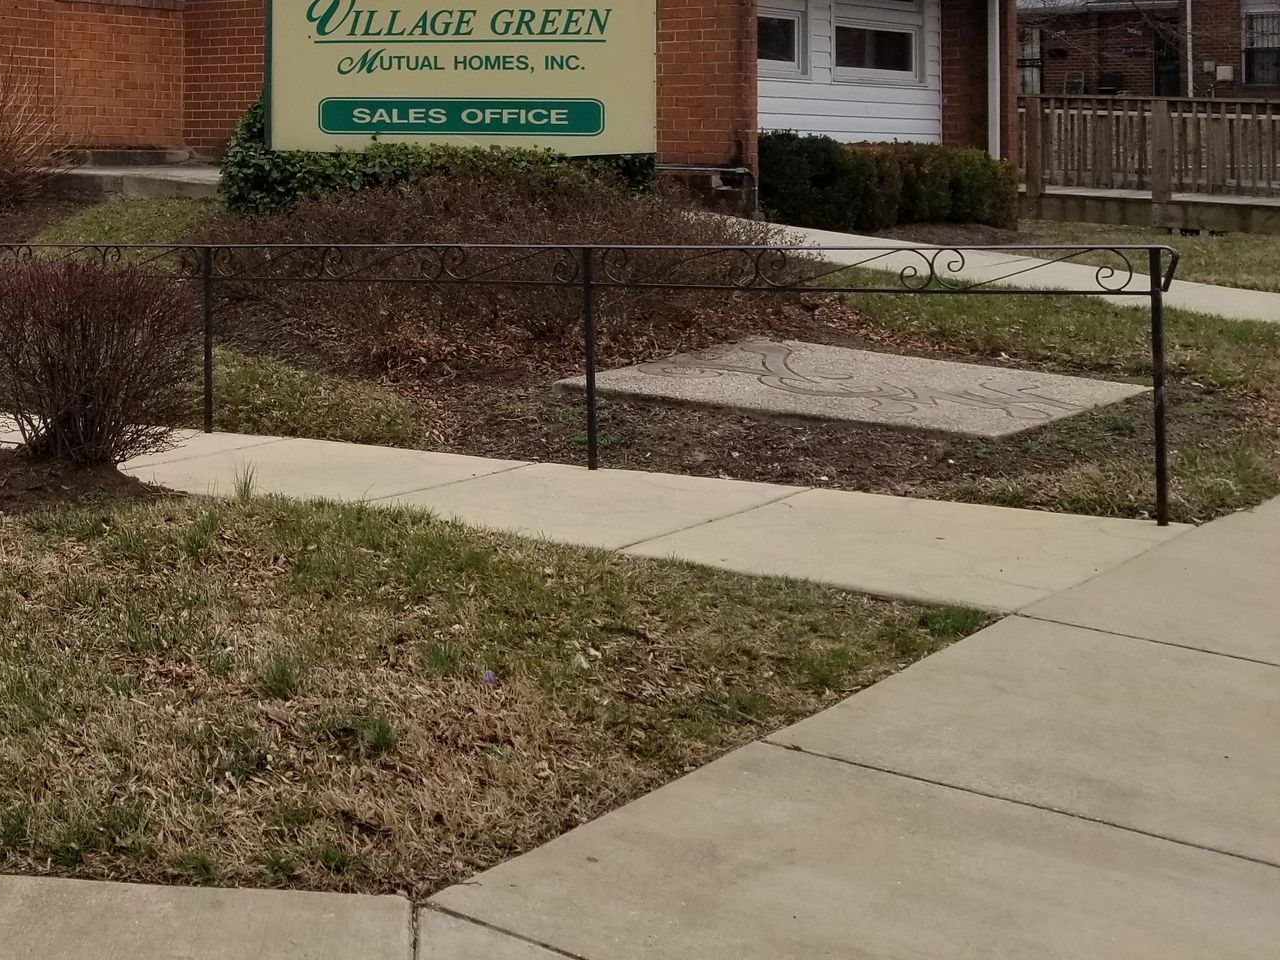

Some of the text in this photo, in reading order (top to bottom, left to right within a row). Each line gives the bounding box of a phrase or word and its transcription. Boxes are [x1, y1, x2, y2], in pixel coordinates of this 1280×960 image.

[490, 8, 613, 36] GREEN
[337, 48, 586, 75] MUTUAL HOMES, INC.
[351, 107, 569, 125] SALES OFFICE
